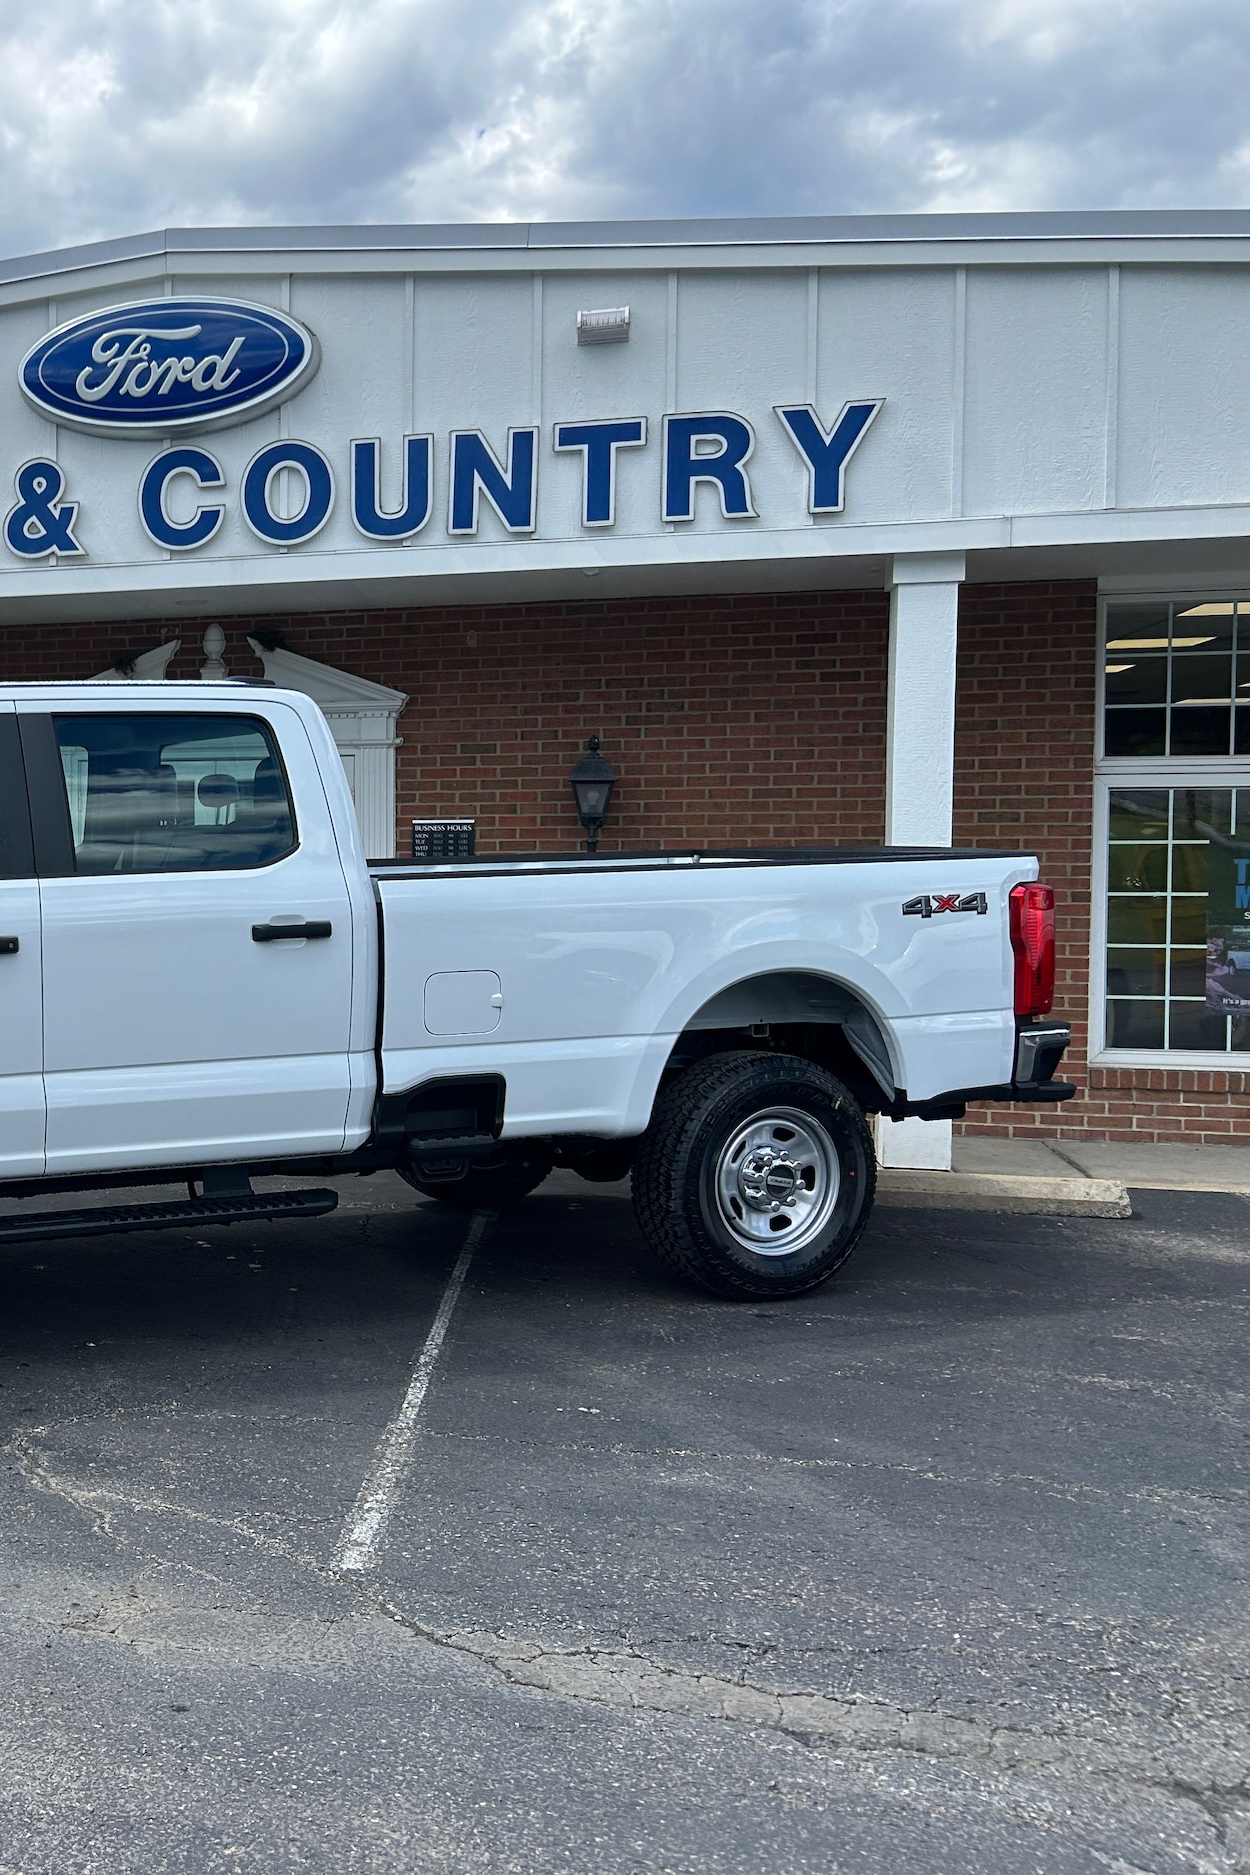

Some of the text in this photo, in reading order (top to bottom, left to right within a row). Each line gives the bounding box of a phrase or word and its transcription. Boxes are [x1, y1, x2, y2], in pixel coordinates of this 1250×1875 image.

[75, 324, 247, 402] Ford
[3, 457, 89, 559] &
[138, 398, 886, 552] COUNTRY
